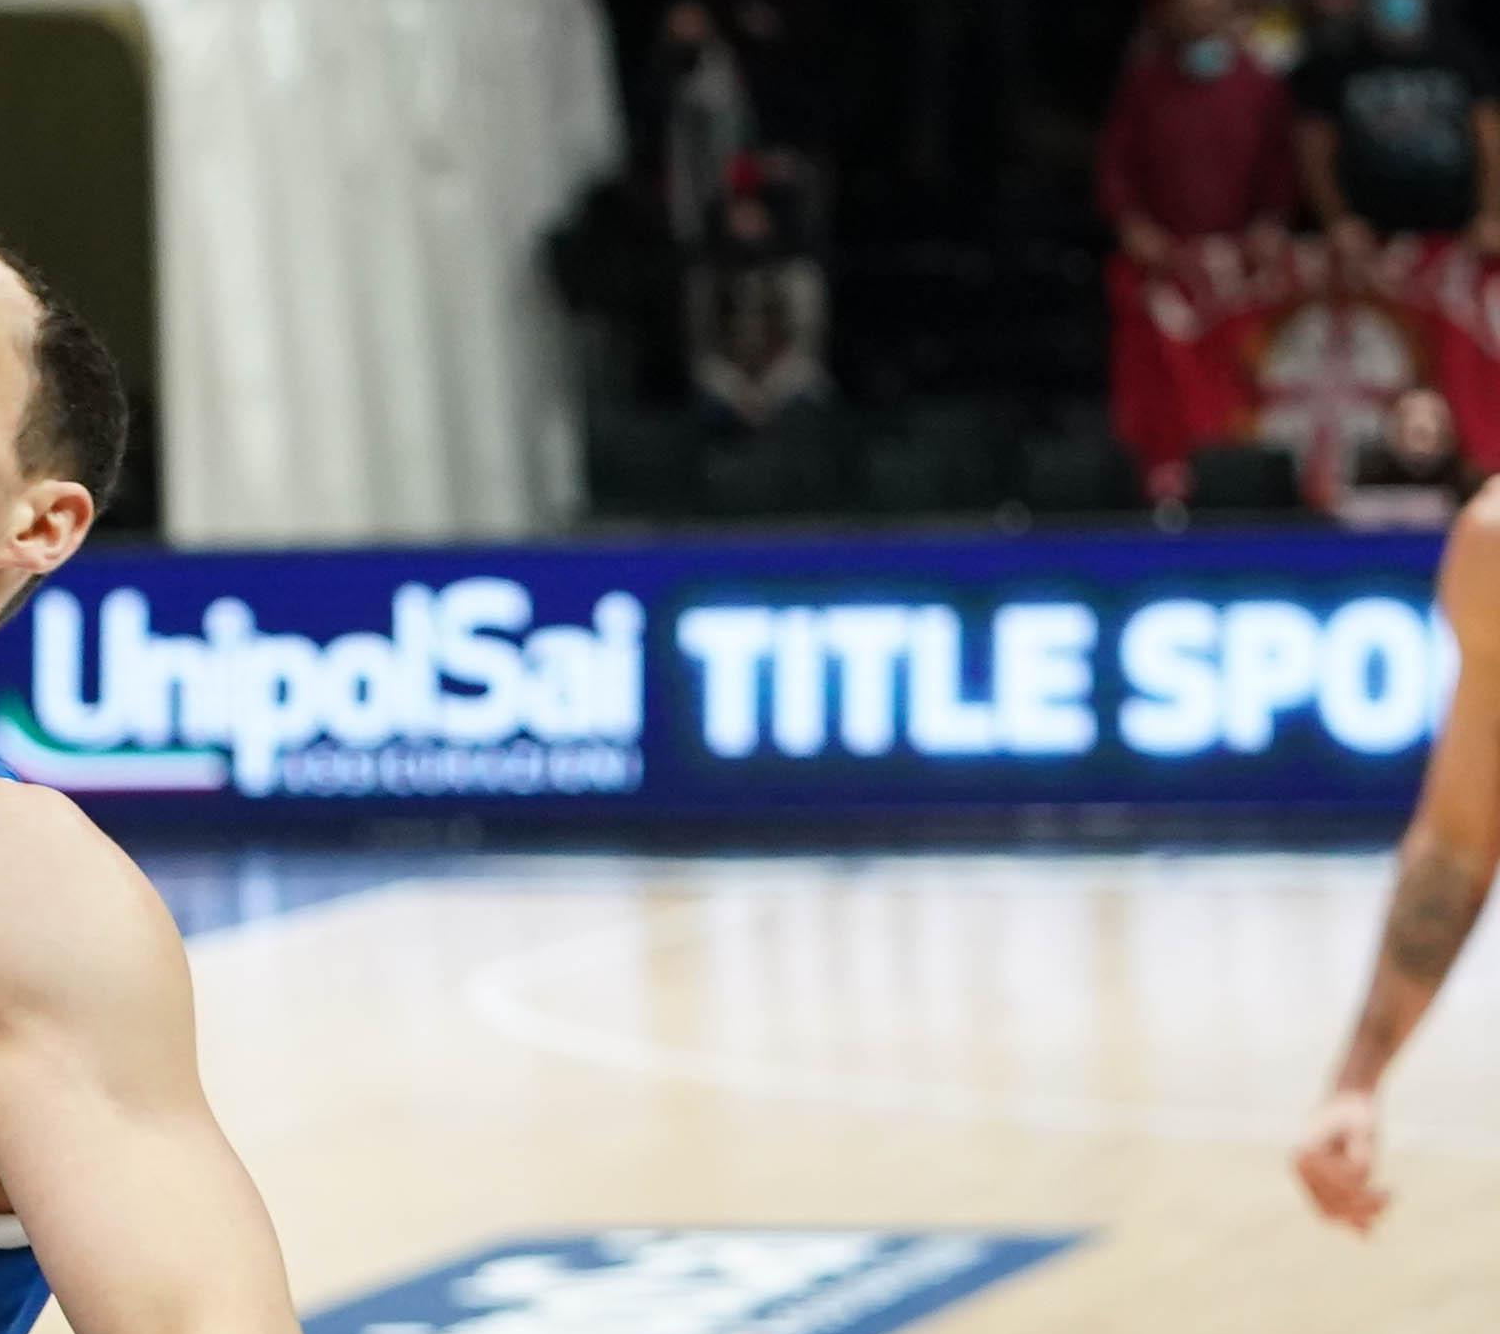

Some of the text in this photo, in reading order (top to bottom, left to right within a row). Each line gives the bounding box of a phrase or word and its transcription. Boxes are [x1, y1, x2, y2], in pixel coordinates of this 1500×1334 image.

[30, 575, 646, 798] UnipolSai
[675, 594, 1462, 758] TITLE SPO
